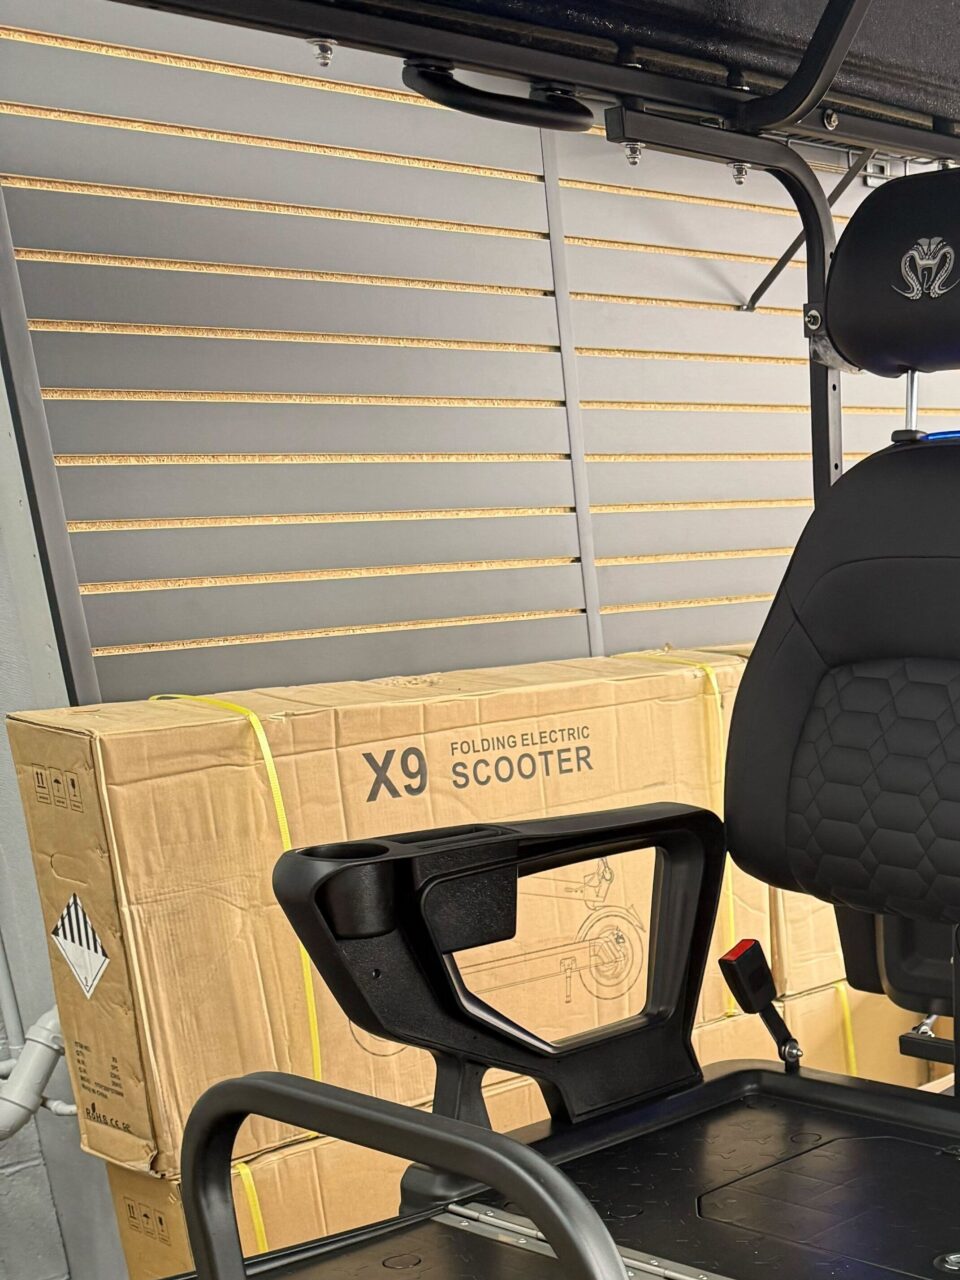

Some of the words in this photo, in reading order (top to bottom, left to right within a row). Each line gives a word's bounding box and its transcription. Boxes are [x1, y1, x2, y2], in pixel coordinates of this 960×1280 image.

[451, 734, 517, 756] FOLDING
[522, 725, 591, 747] ELECTRIC
[362, 746, 428, 803] X9
[451, 745, 593, 790] SCOOTER
